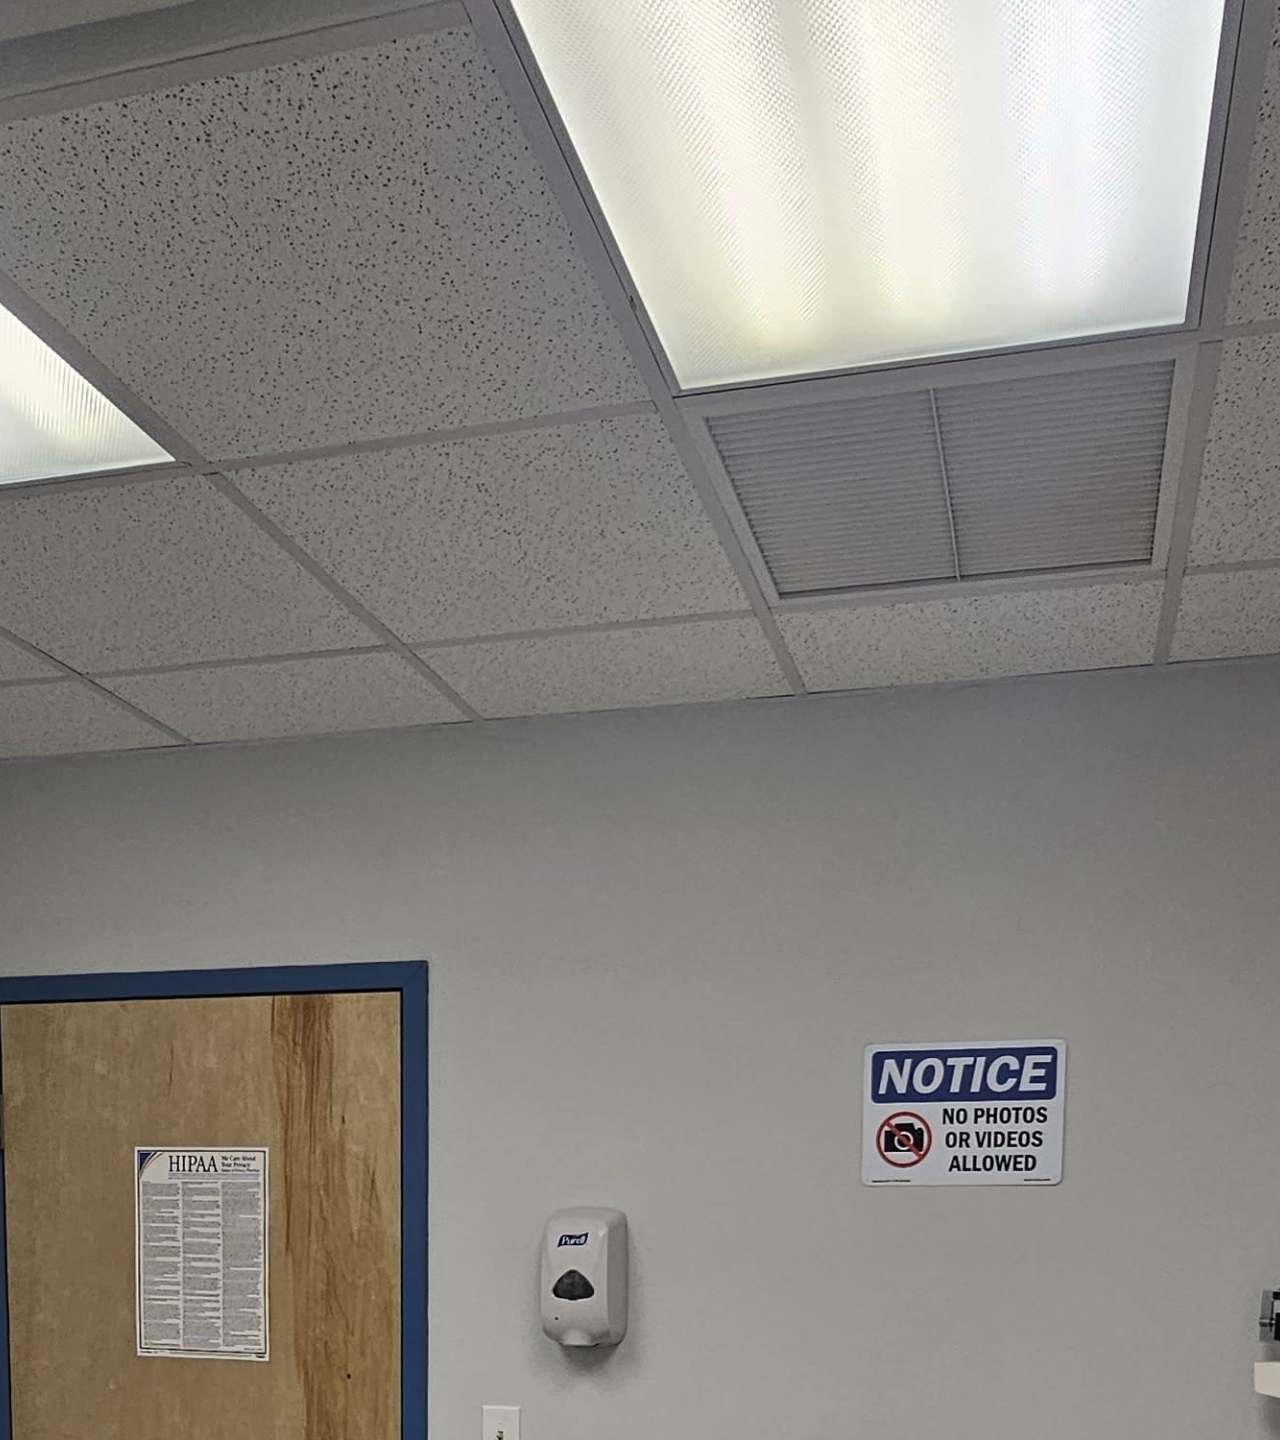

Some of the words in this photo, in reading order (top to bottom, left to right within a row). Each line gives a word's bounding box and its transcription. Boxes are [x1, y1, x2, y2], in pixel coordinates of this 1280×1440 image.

[878, 1055, 1052, 1094] NOTICE
[942, 1108, 968, 1124] NO
[973, 1107, 1048, 1124] PHOTOS
[945, 1131, 970, 1148] OR
[975, 1131, 1043, 1148] VIDEOS
[168, 1155, 218, 1172] HIPAA
[948, 1155, 1037, 1172] ALLOWED
